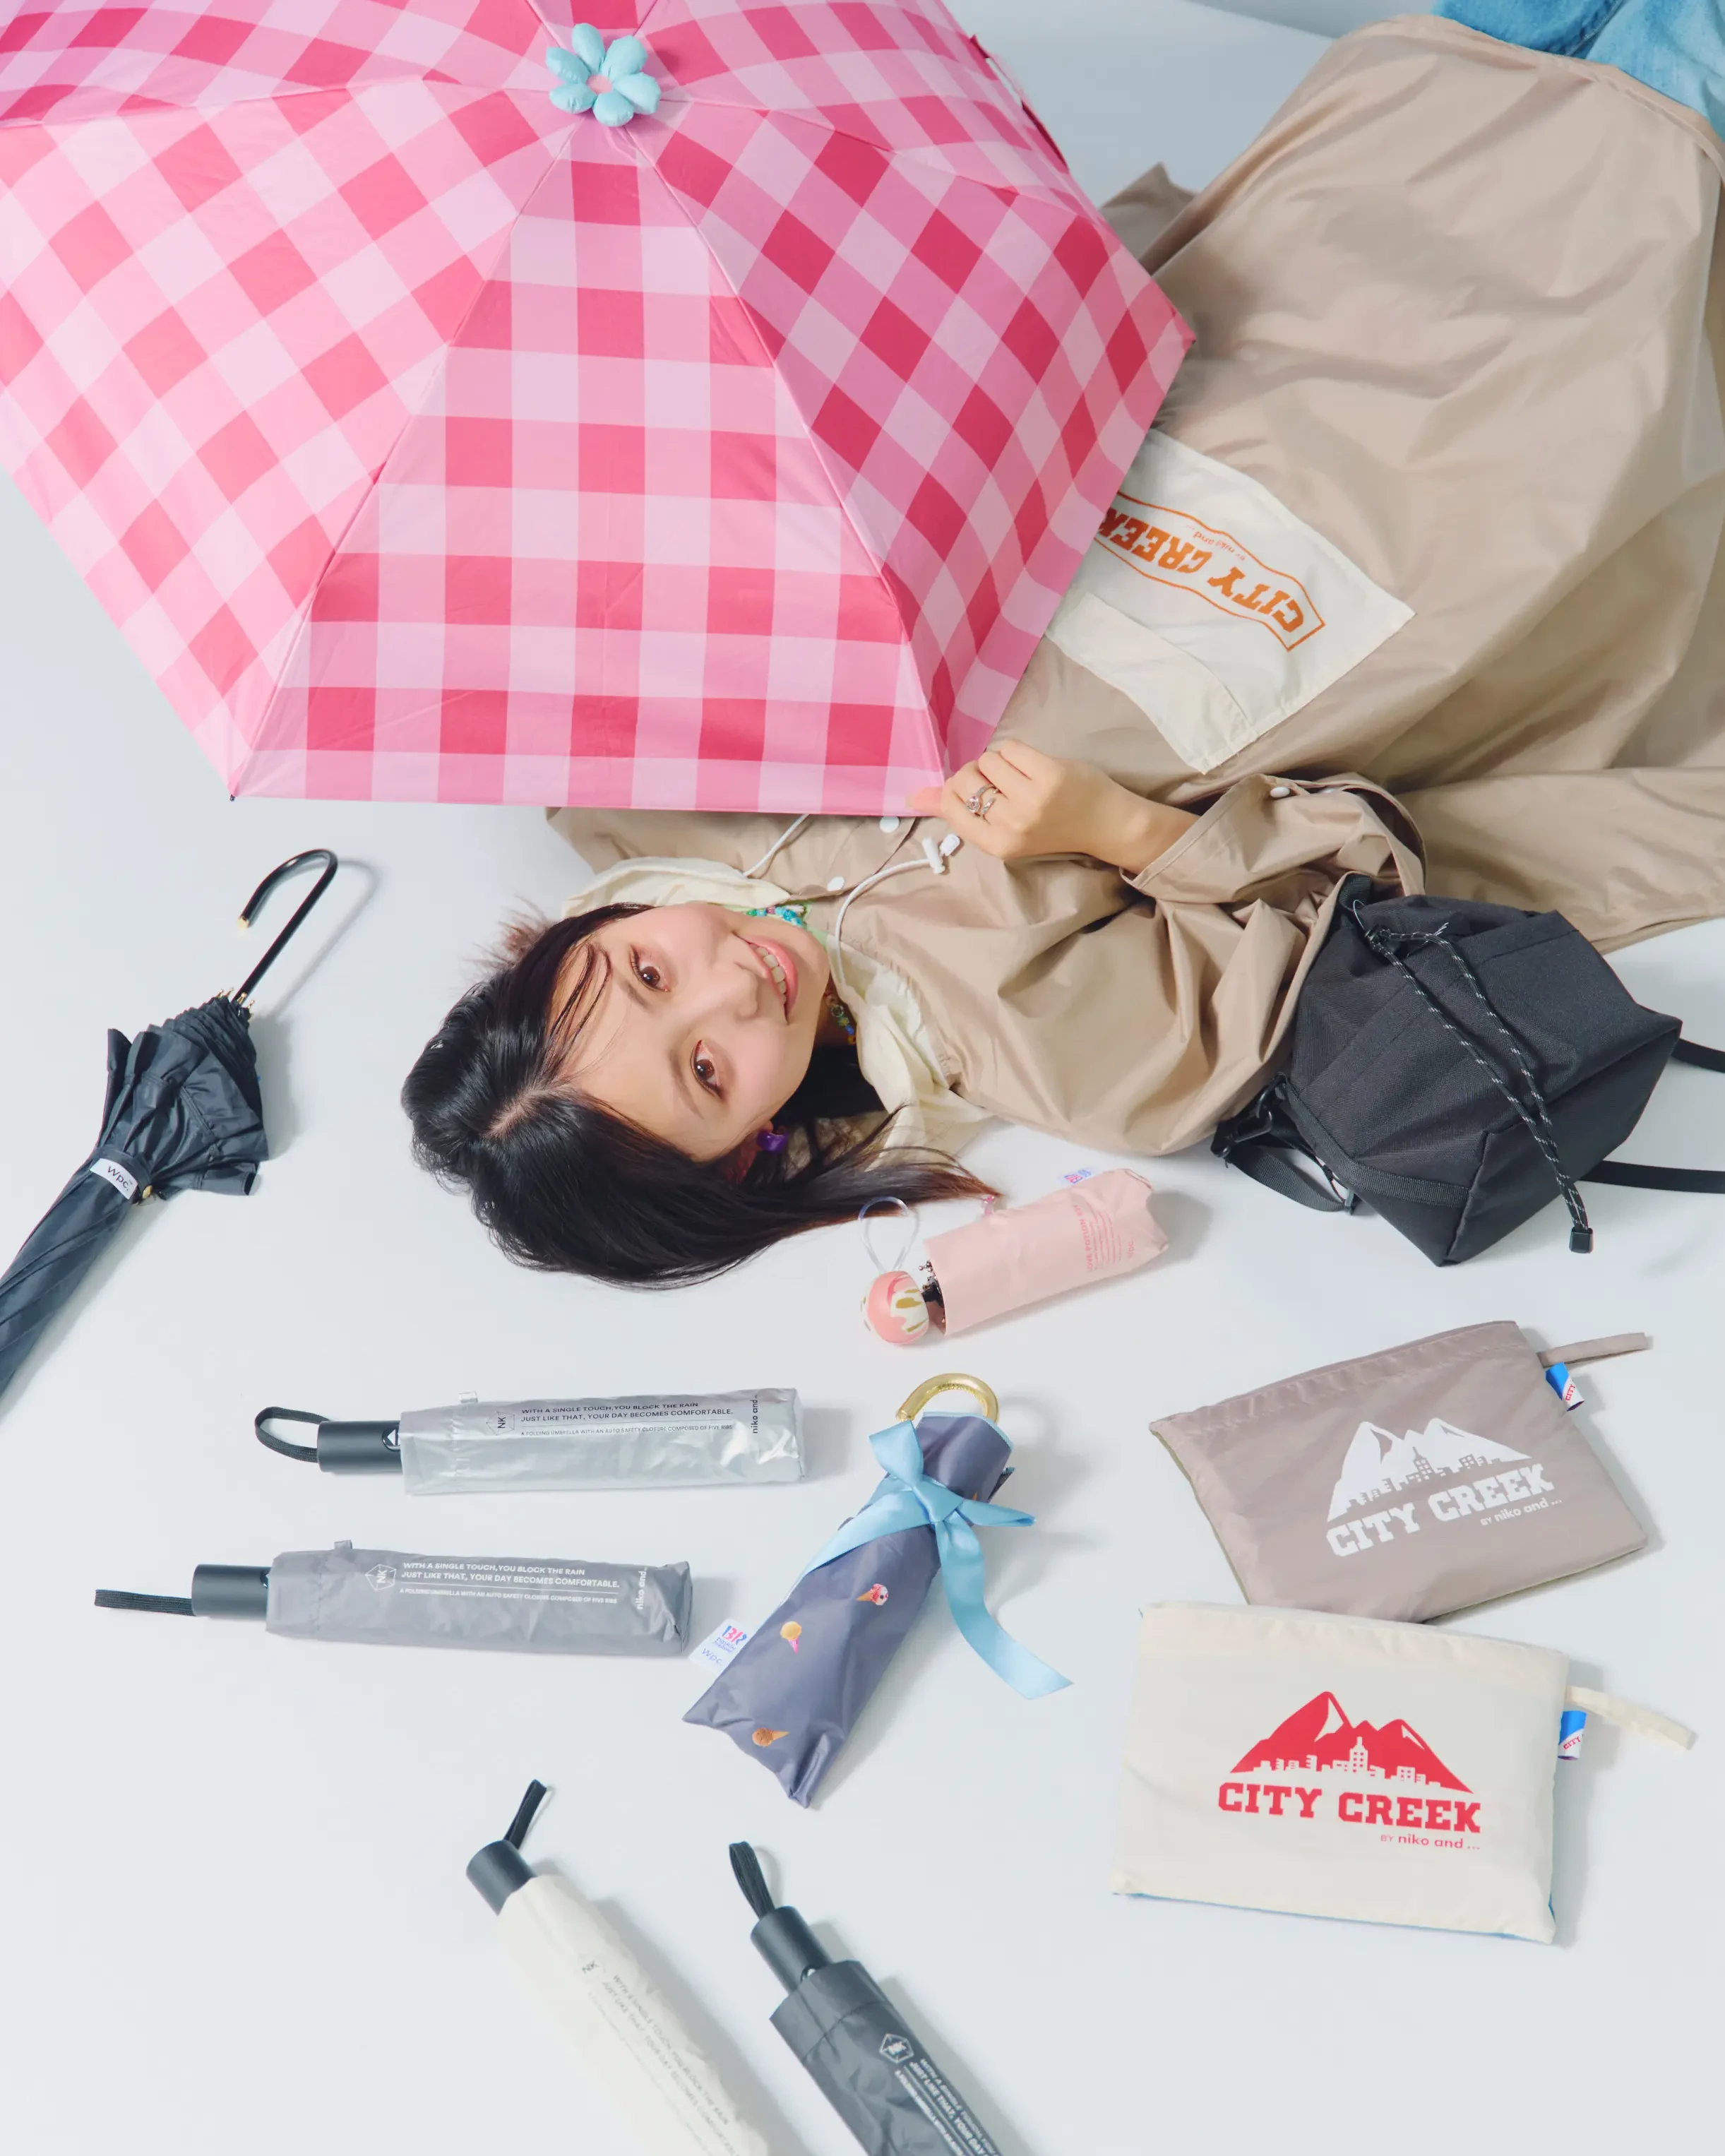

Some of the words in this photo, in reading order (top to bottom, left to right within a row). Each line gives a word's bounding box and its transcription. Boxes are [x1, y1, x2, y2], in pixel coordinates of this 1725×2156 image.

[1207, 566, 1305, 633] CITY
[1079, 1219, 1092, 1251] POTION
[1565, 1383, 1575, 1401] CITY
[497, 1416, 506, 1429] NK
[1326, 1502, 1421, 1556] CITY
[1428, 1463, 1555, 1522] CREEK
[1494, 1508, 1522, 1522] niko
[1523, 1497, 1549, 1513] and
[443, 1573, 467, 1581] THAT,
[513, 1576, 554, 1585] BECOMES
[555, 1578, 620, 1588] COMFORTABLE.
[1563, 1735, 1582, 1751] CITY
[1218, 1782, 1323, 1818] CITY
[1338, 1792, 1481, 1833] CREEK
[1398, 1833, 1429, 1846] niko
[1434, 1838, 1464, 1849] and
